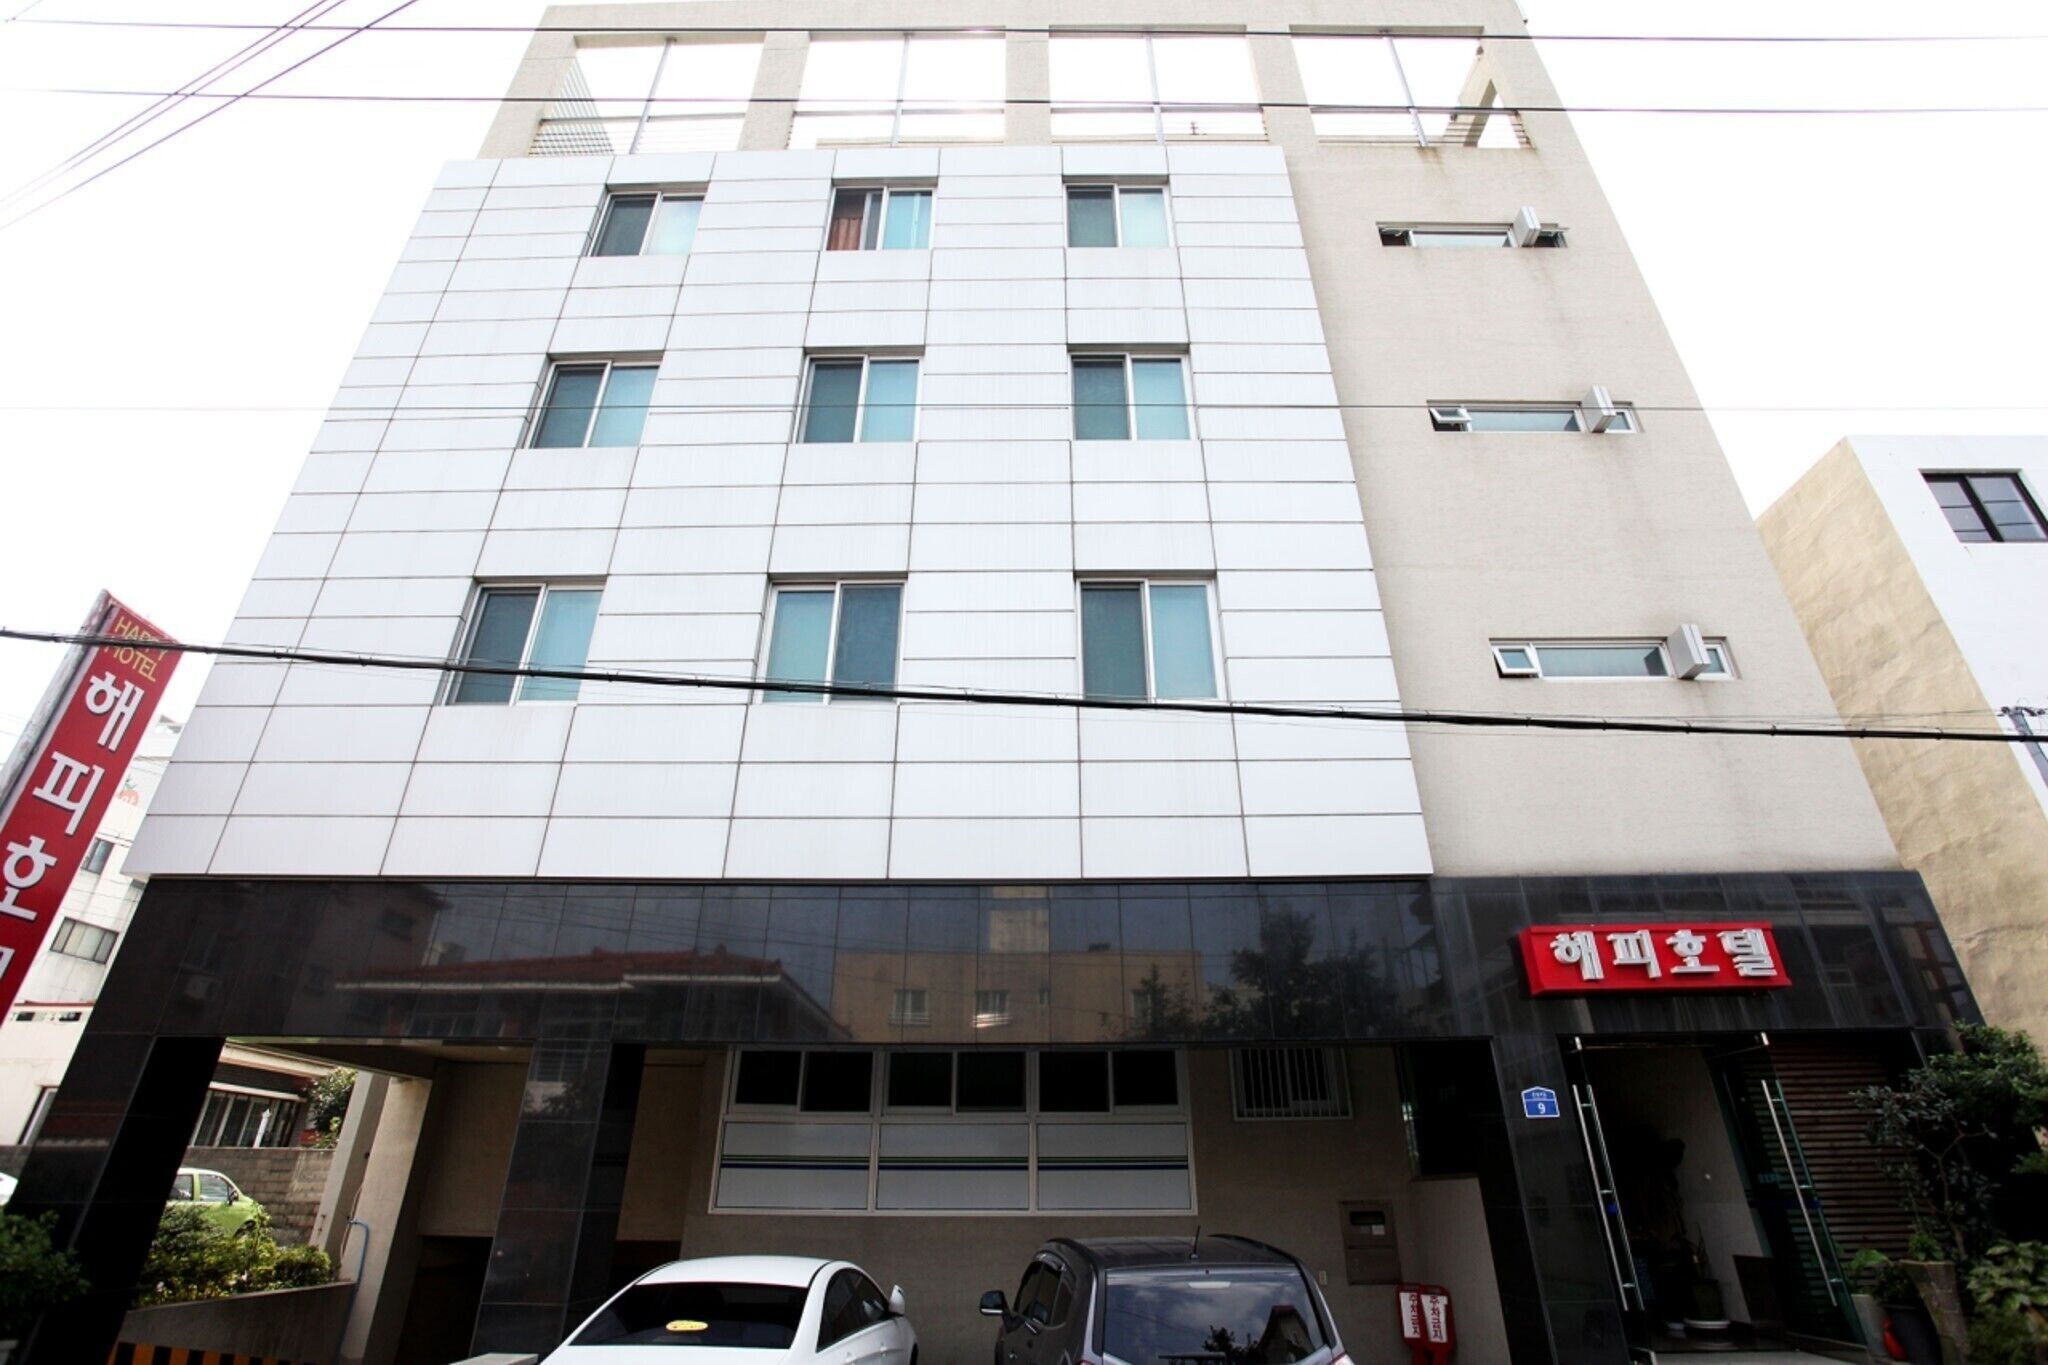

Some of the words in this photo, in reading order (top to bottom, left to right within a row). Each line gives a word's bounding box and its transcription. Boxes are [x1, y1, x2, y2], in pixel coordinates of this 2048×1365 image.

[0, 672, 144, 980] 해피호
[1550, 928, 1778, 981] 해피호텔
[1537, 1102, 1546, 1115] 9
